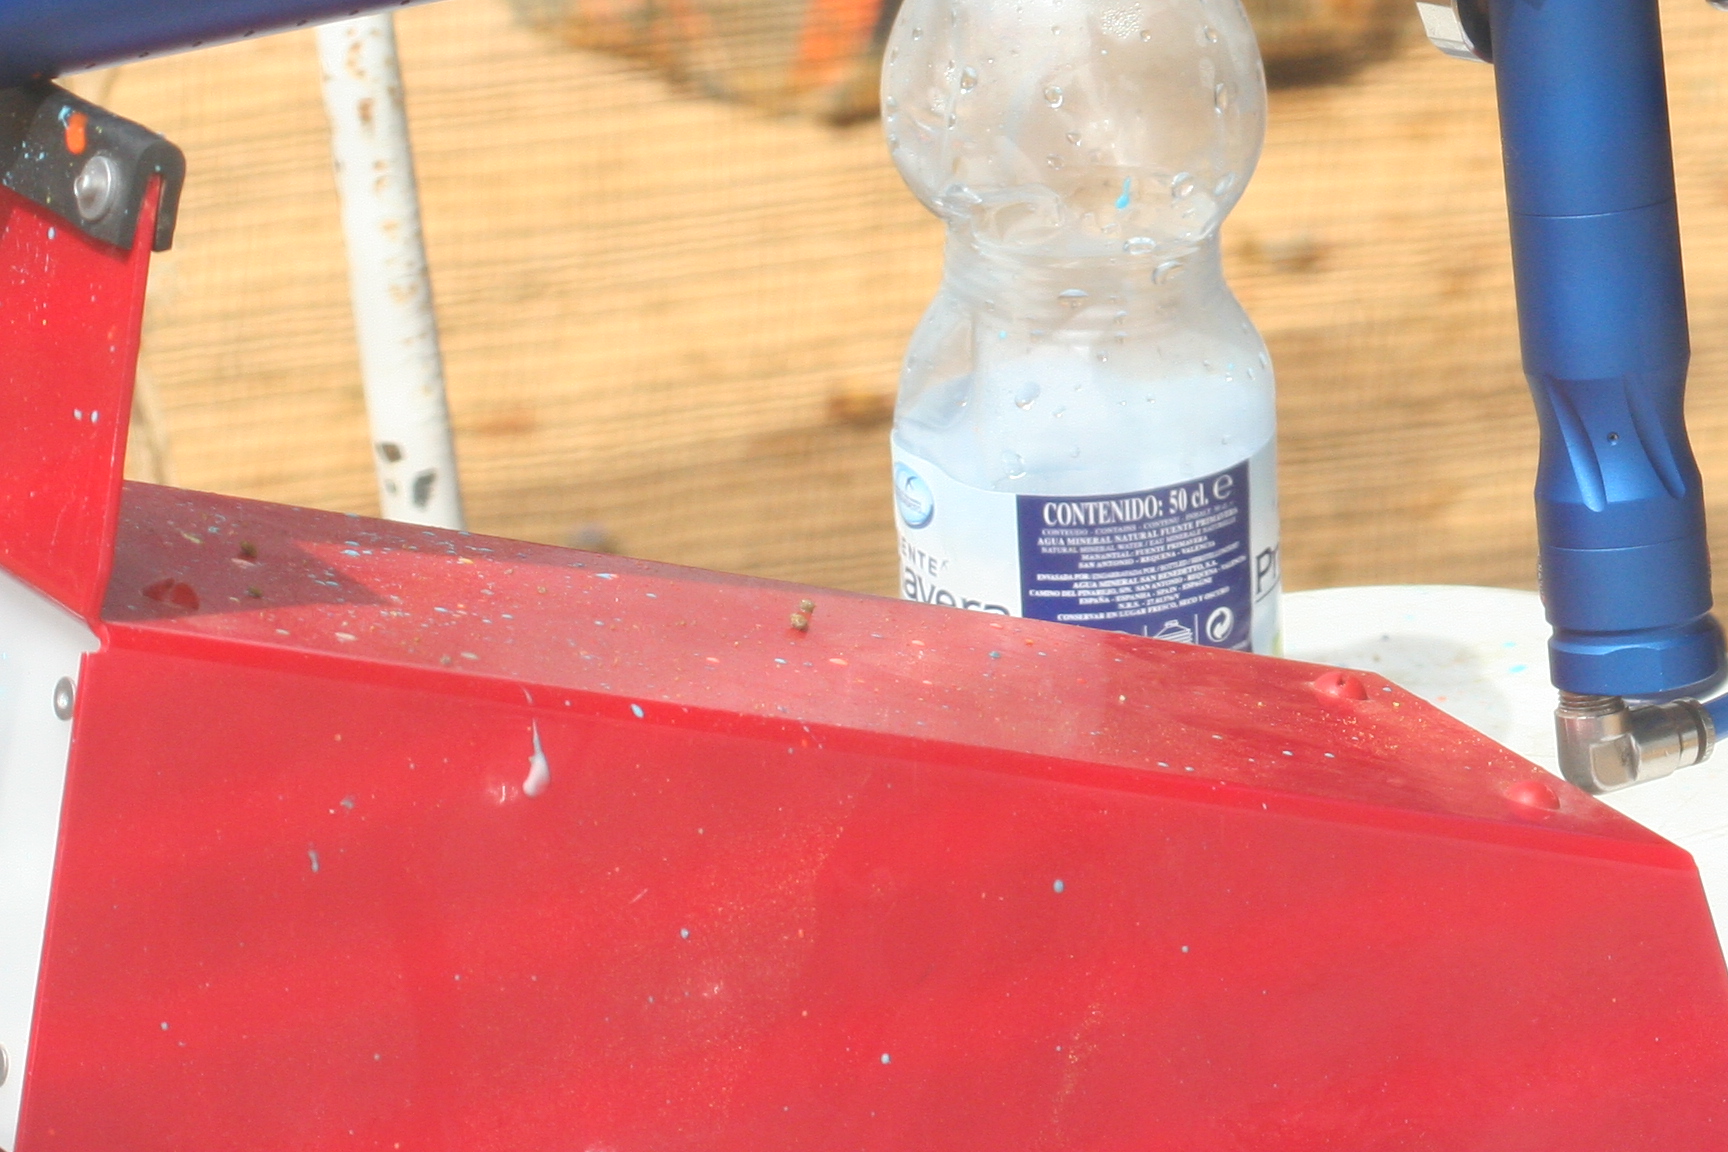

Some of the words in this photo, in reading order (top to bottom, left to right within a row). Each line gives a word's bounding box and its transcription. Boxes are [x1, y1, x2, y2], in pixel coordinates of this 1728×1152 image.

[1043, 495, 1163, 526] CONTENIDO:
[1169, 487, 1188, 515] 50
[1037, 537, 1066, 546] AGUA
[1066, 535, 1113, 546] MINERAL
[1114, 529, 1159, 543] NATURAL
